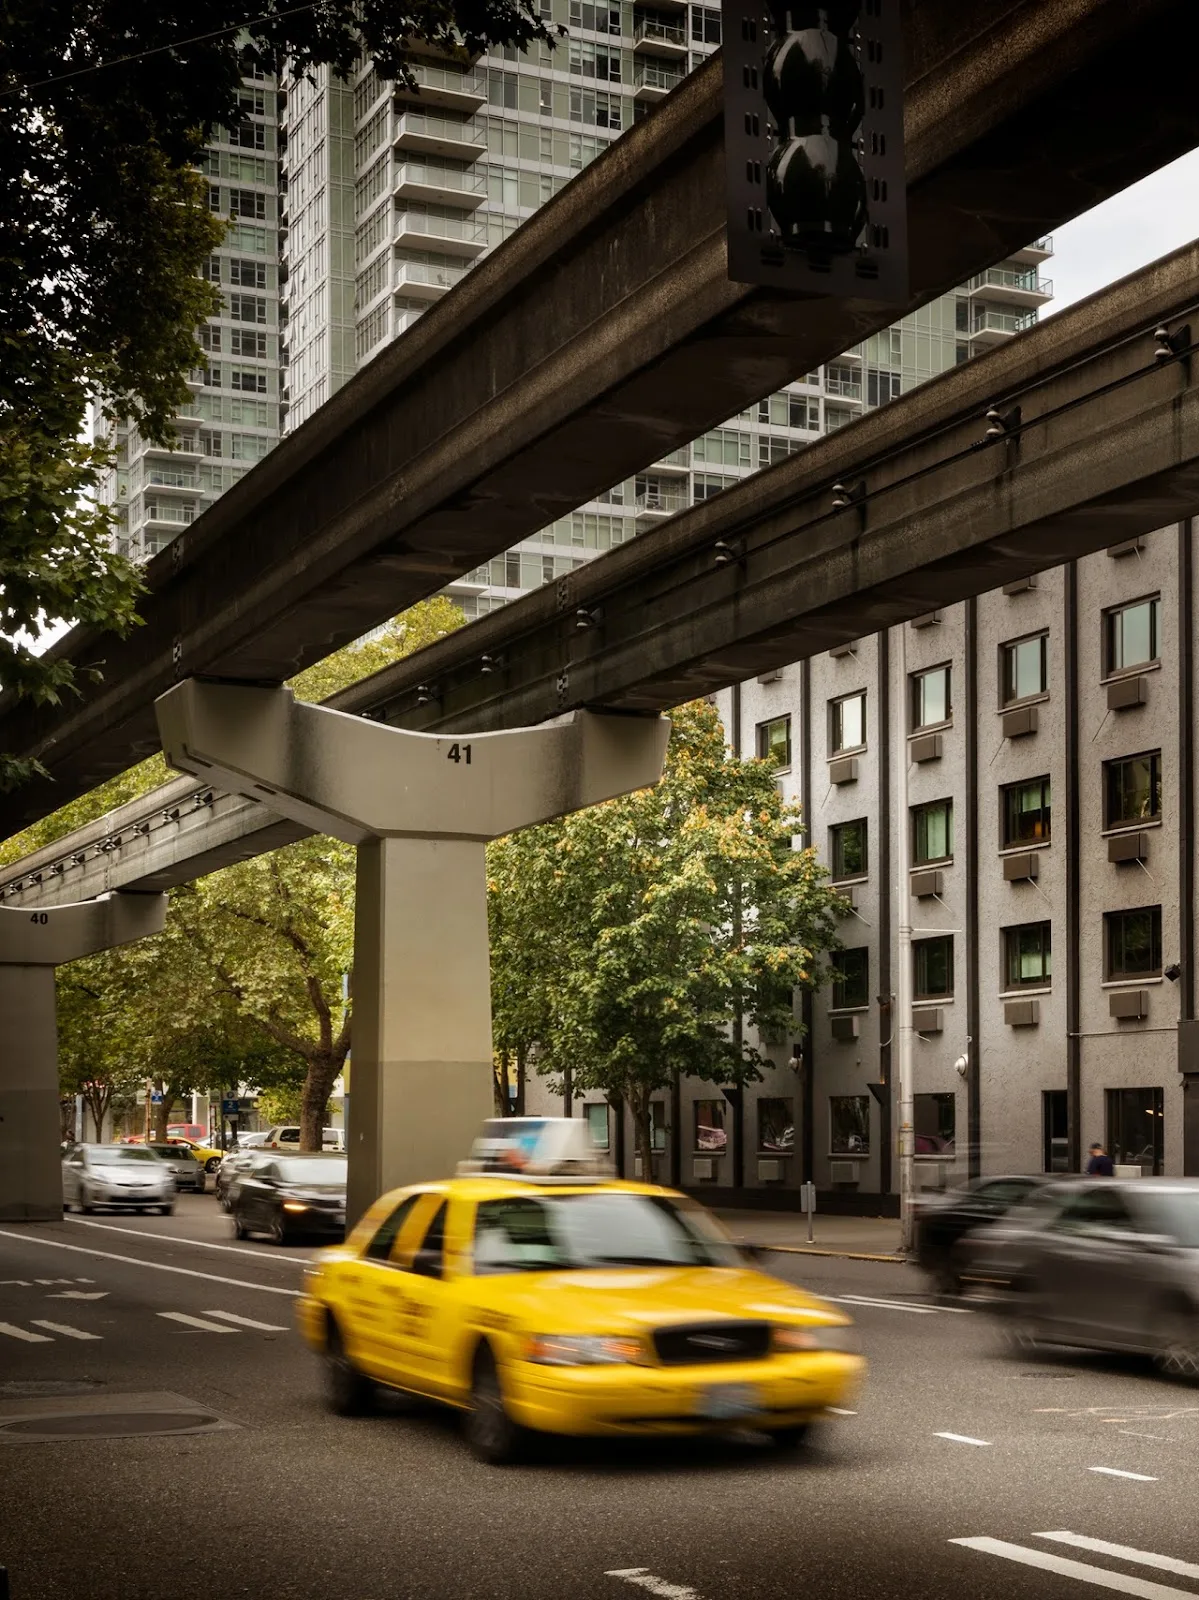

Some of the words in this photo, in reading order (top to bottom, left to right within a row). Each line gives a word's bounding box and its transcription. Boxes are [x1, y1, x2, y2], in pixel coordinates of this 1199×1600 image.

[447, 743, 472, 765] 41
[30, 912, 49, 925] 40
[227, 1101, 234, 1109] 2
